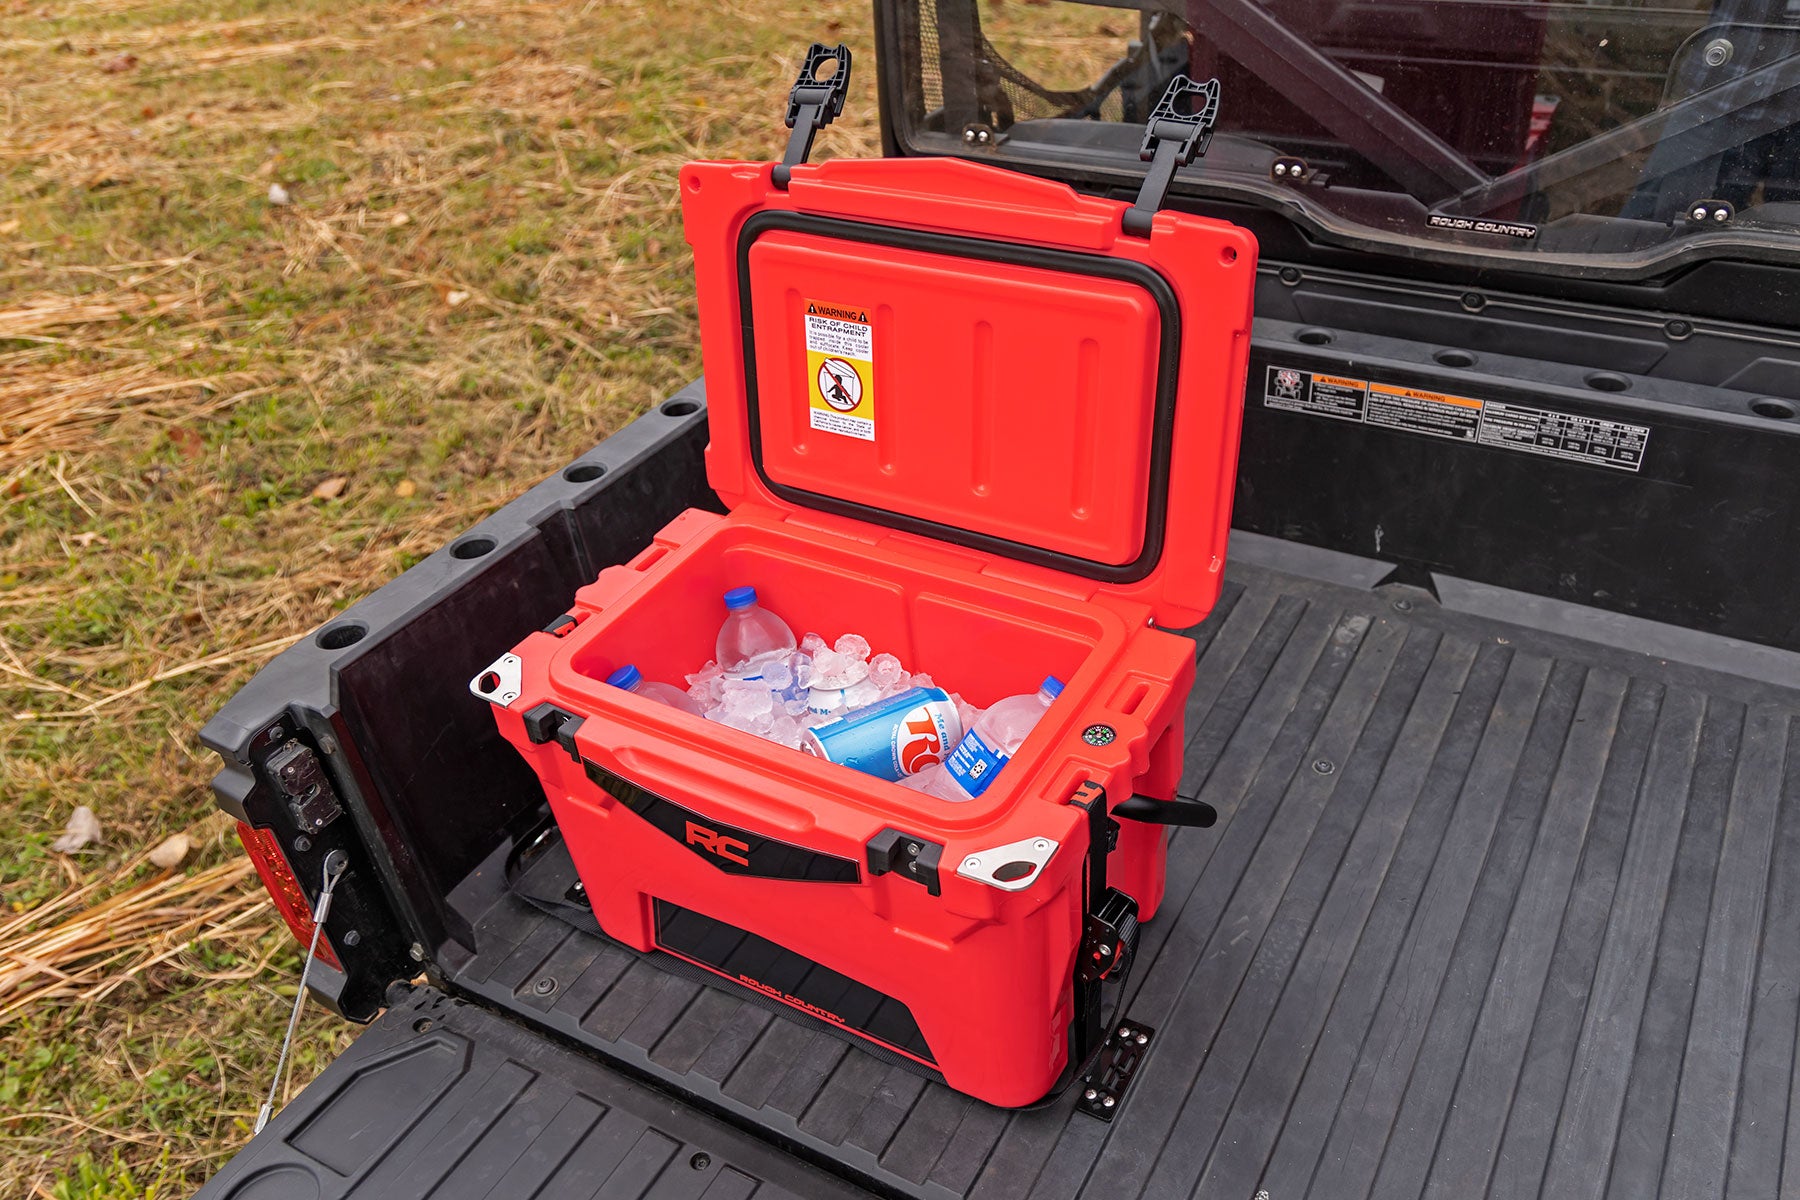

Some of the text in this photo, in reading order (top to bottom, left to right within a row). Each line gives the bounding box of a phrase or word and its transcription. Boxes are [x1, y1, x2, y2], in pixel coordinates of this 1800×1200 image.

[1430, 216, 1535, 237] ROUGH COUNTRY
[818, 306, 856, 320] WARNING
[809, 317, 827, 325] RISK
[843, 323, 867, 332] CHILD
[812, 323, 866, 337] ENTRAPMENT
[1328, 377, 1358, 387] WARNING
[1413, 392, 1445, 402] WARNING
[890, 723, 899, 740] ROYAL
[936, 713, 945, 730] Me
[941, 732, 950, 751] and
[890, 740, 898, 761] CROWN
[686, 820, 749, 867] RC
[740, 974, 845, 1023] ROUGH COUNTRY
